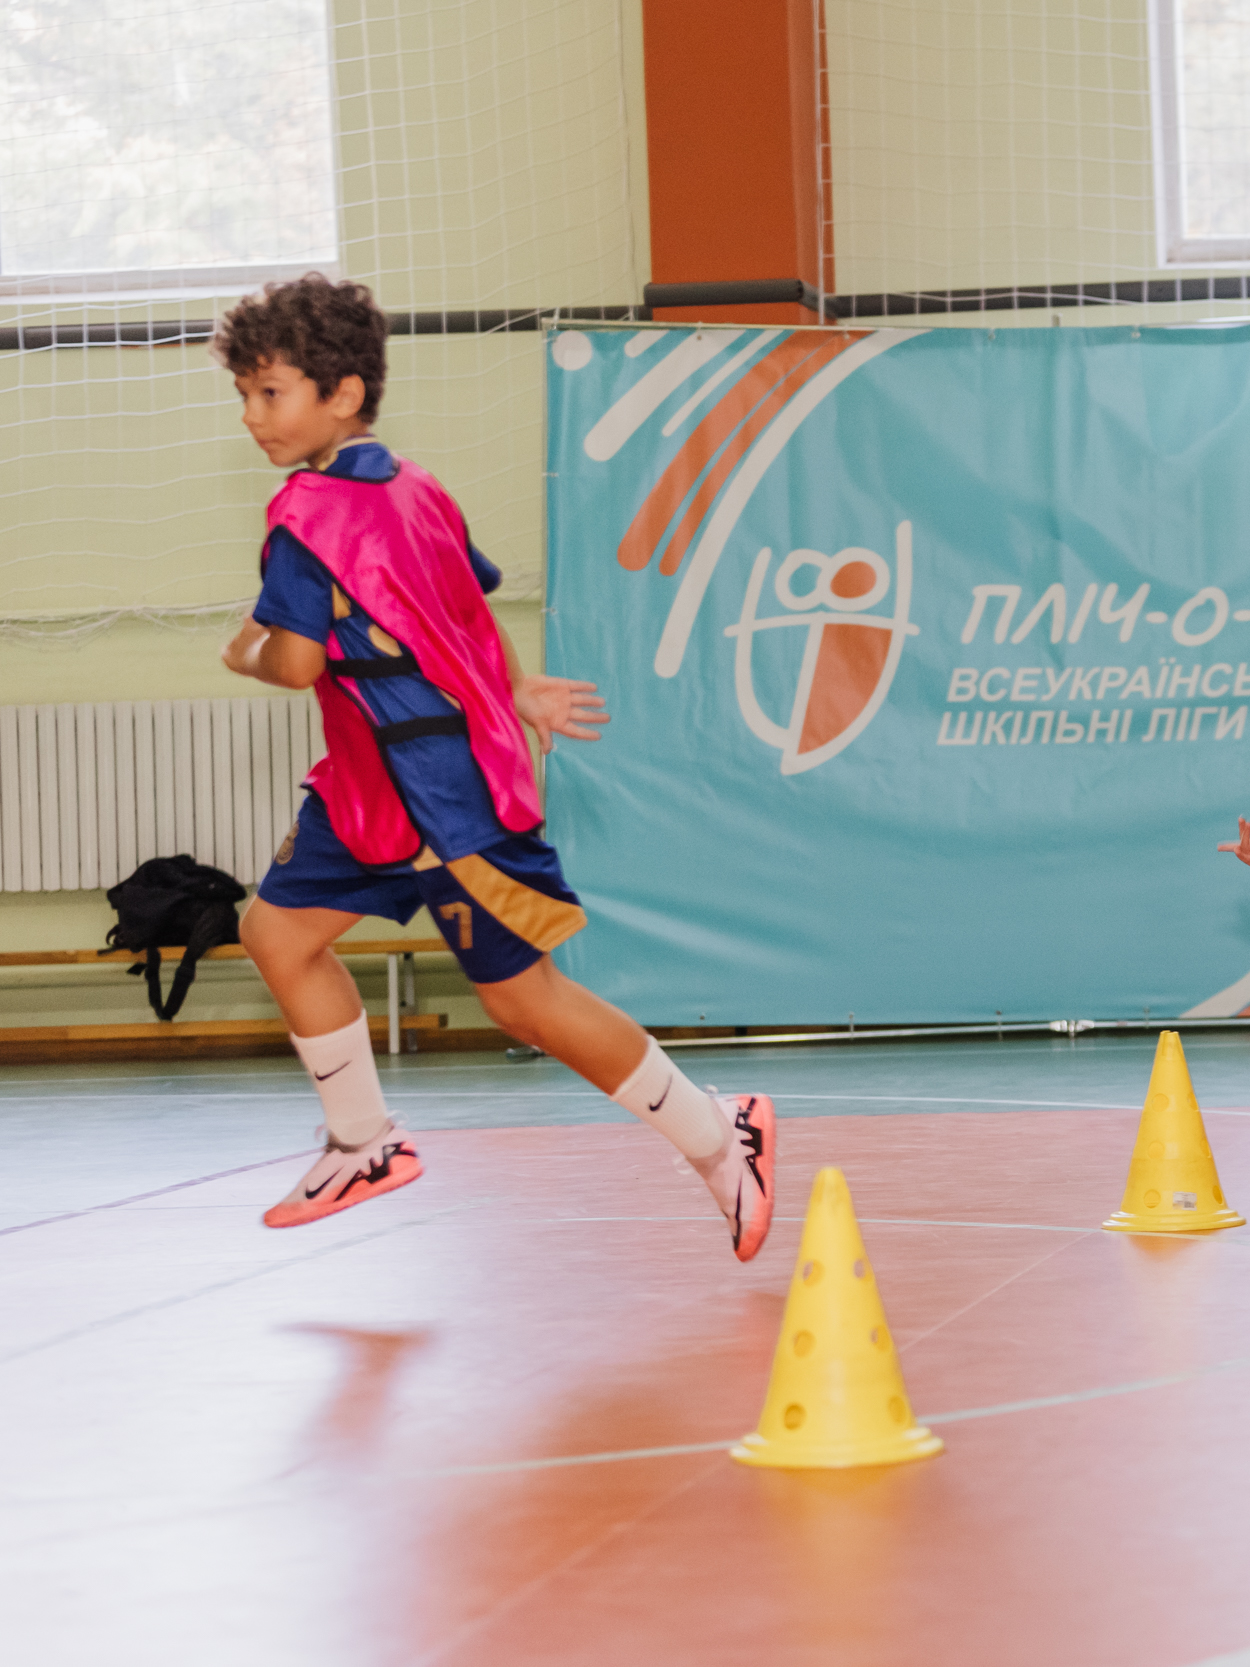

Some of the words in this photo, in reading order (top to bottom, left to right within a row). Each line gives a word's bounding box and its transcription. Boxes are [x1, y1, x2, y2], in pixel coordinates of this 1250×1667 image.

[936, 708, 1132, 745] ШКІЛЬНІ
[1142, 706, 1248, 742] ЛІГИ
[439, 901, 473, 949] 7
